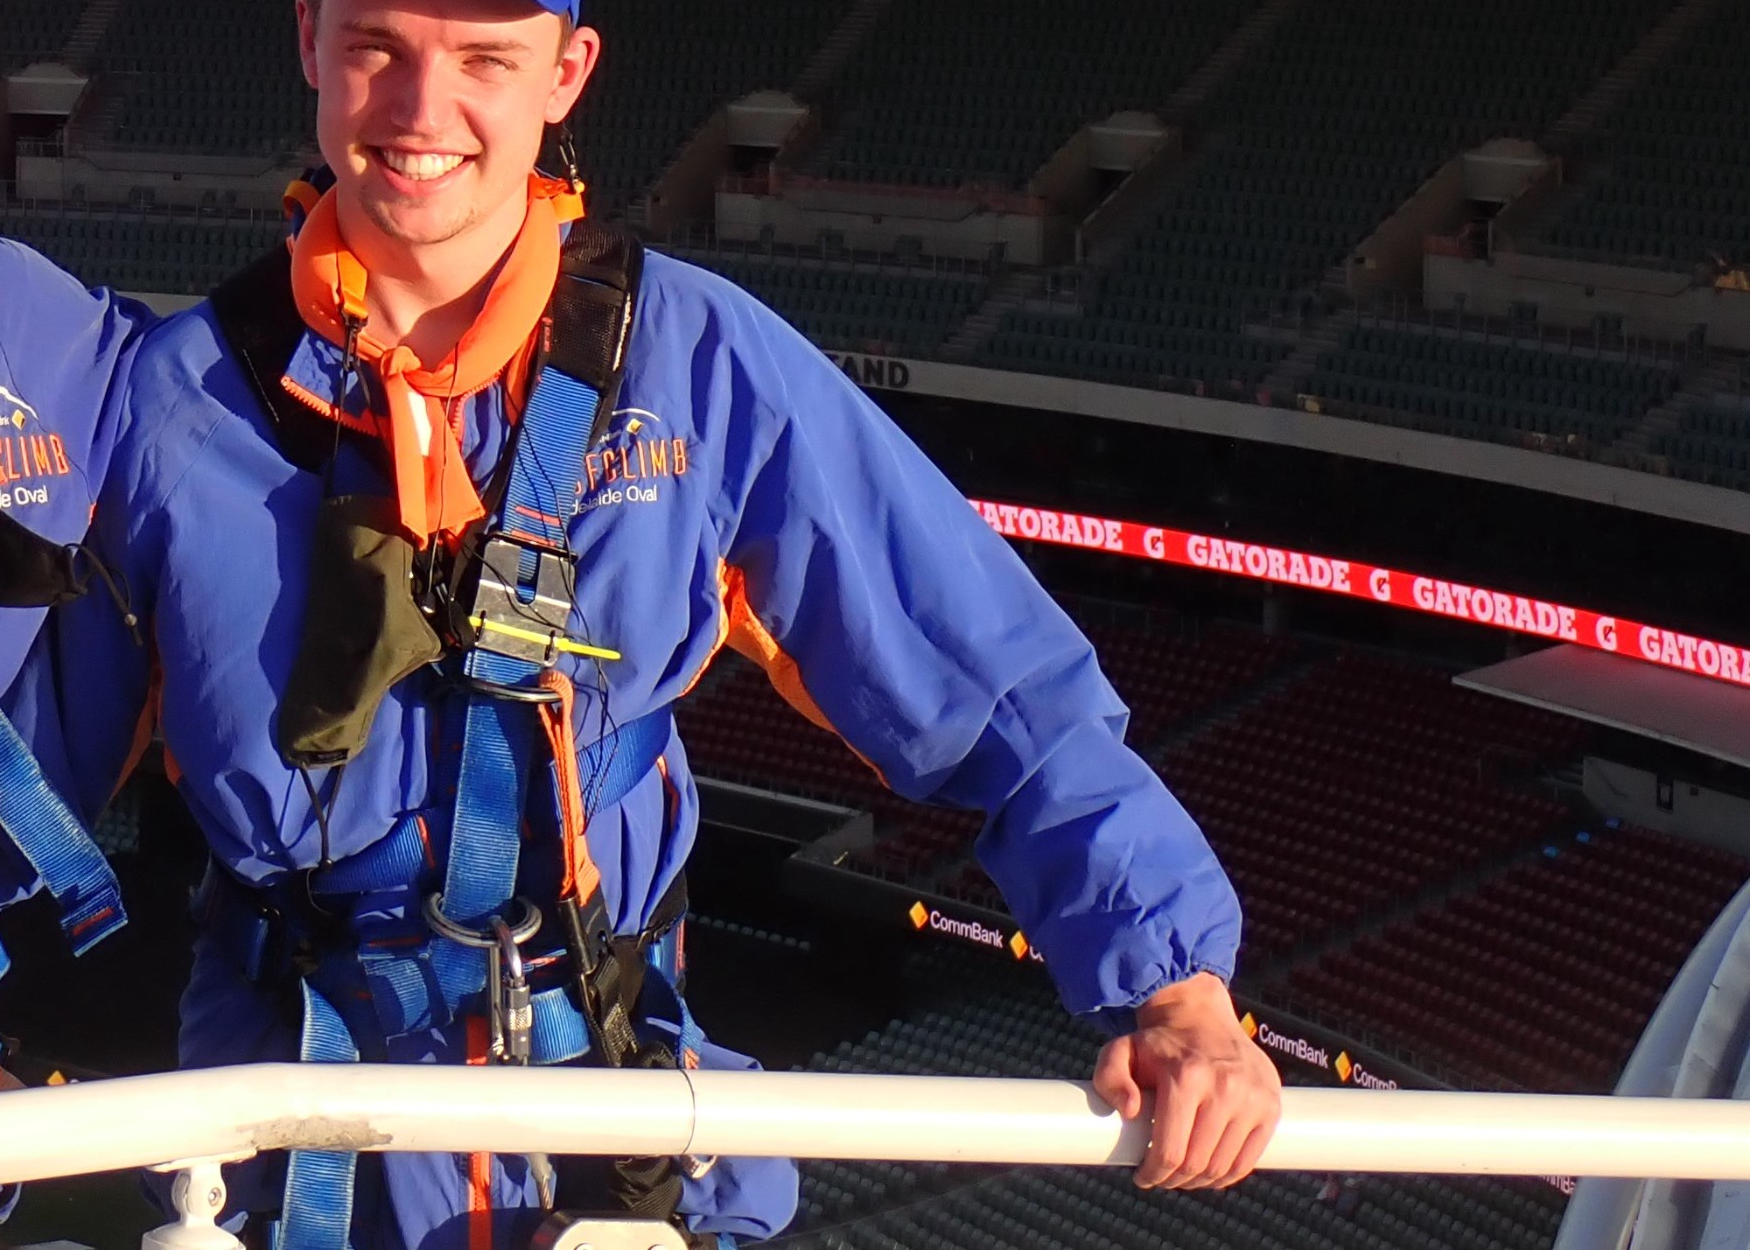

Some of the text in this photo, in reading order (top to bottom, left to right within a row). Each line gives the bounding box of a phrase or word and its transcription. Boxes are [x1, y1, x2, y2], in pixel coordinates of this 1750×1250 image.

[14, 485, 48, 506] Oval
[626, 484, 658, 502] Oval
[1187, 534, 1351, 592] GATORADE
[1413, 576, 1577, 641] GATORADE
[1639, 625, 1750, 685] GATOR
[930, 910, 1004, 948] CommBank
[1259, 1023, 1329, 1069] CommBank
